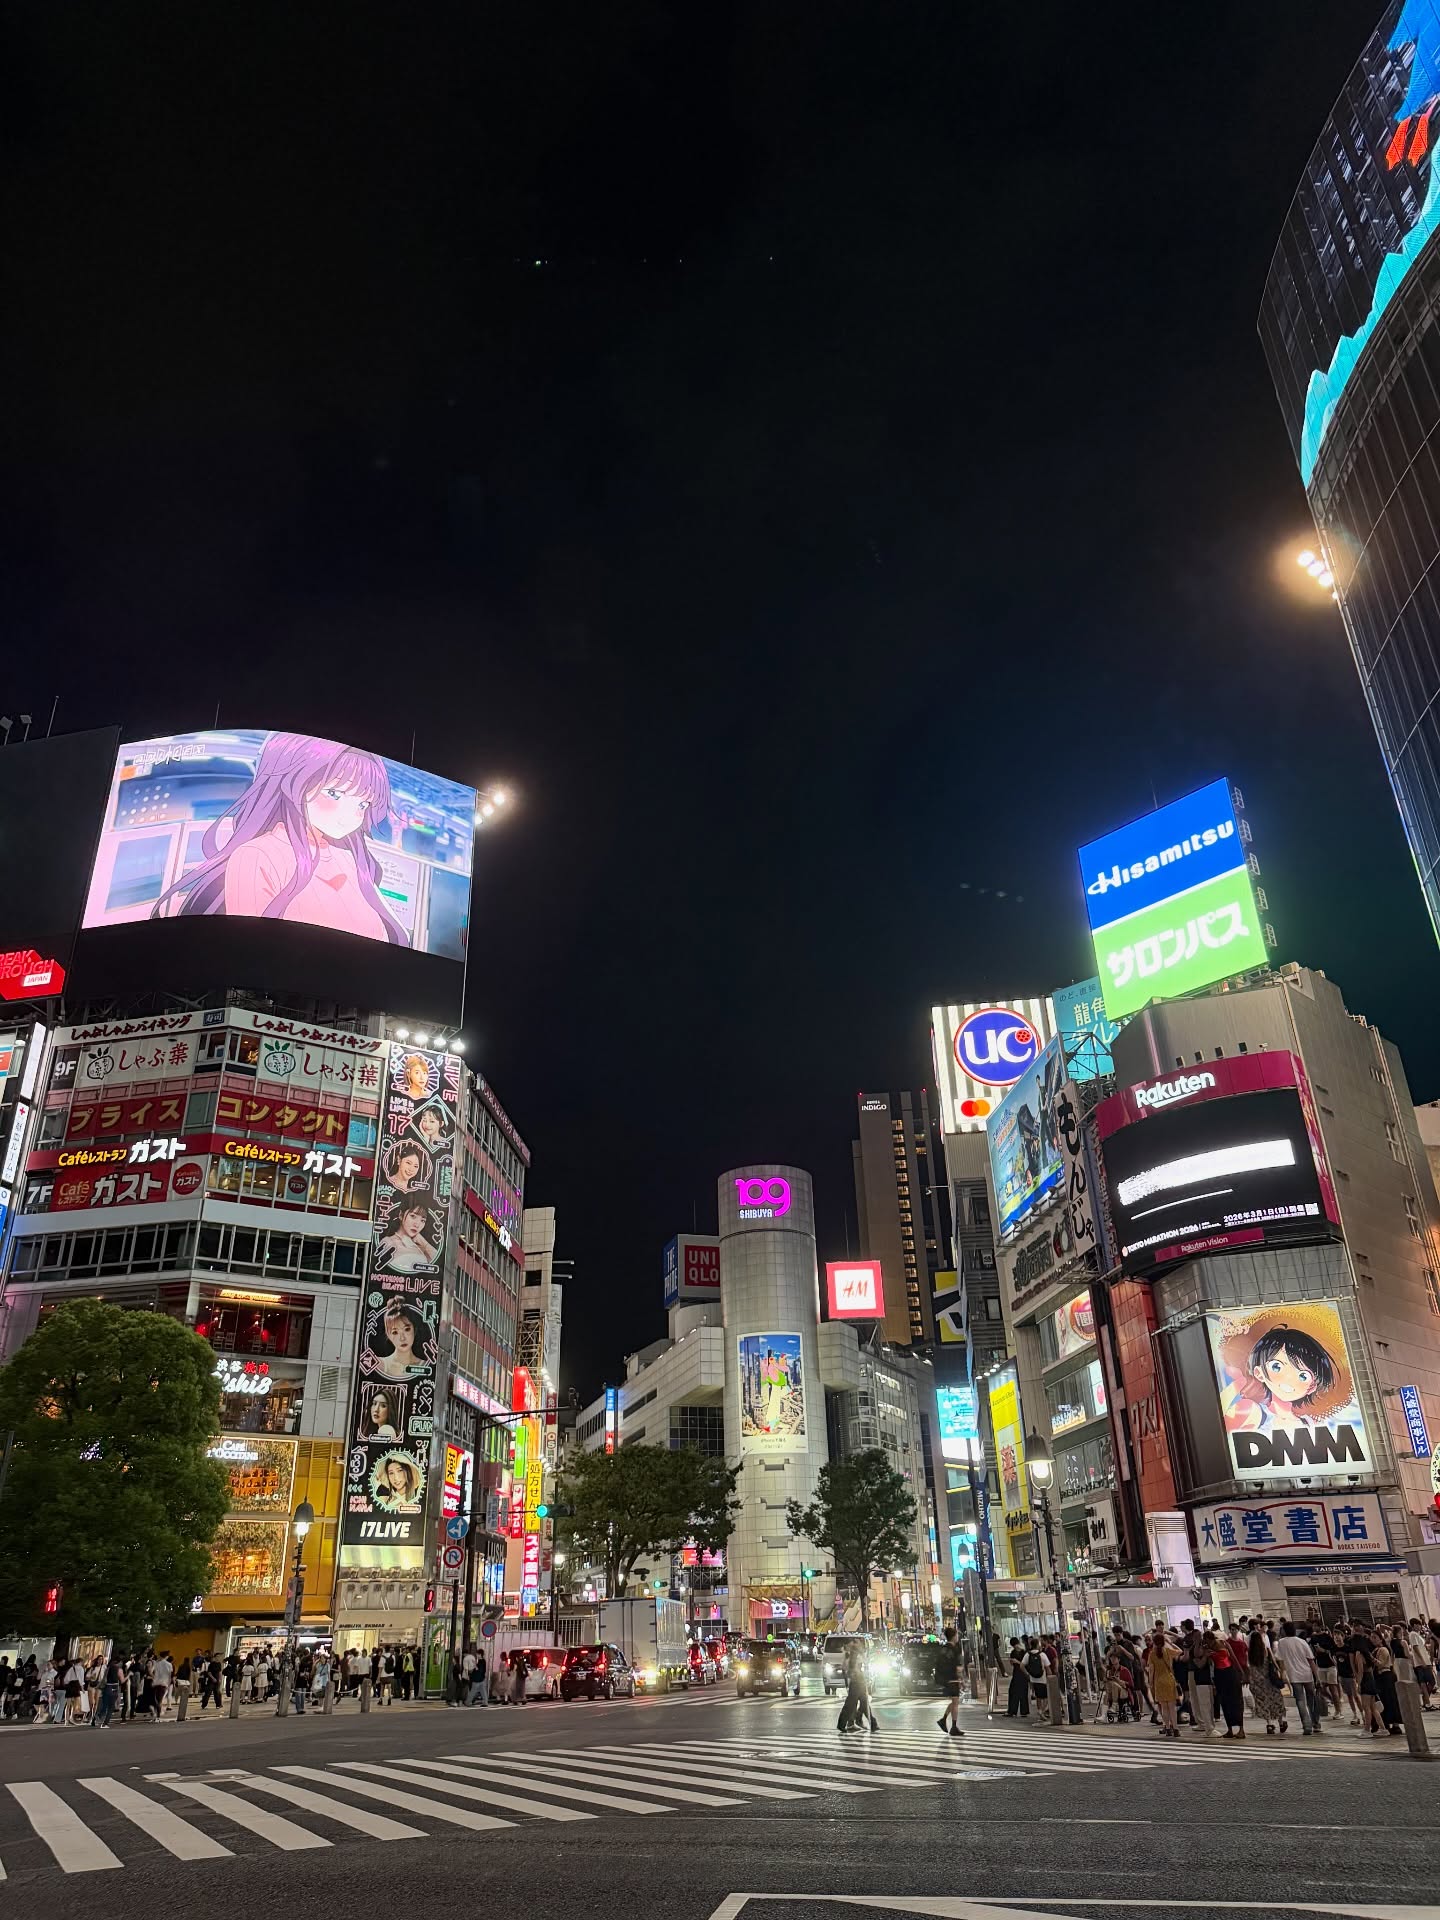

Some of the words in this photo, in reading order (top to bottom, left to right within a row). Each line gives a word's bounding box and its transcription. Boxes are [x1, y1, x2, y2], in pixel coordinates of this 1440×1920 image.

[1088, 820, 1234, 895] Hisamitsu
[1106, 901, 1249, 988] サロンパス
[27, 975, 49, 983] JAPAN
[71, 1014, 192, 1040] しゃぶしゃぶバイキング
[252, 1015, 382, 1052] しゃぶしゃぶバイキング
[54, 1060, 76, 1077] 9F
[119, 1042, 188, 1070] しゃぶ葉
[303, 1053, 379, 1088] しゃぶ葉
[1135, 1072, 1215, 1109] Rakuten
[71, 1100, 180, 1133] プライス
[219, 1097, 346, 1137] コンタクト
[388, 1114, 412, 1136] 17
[129, 1138, 187, 1163] ガスト
[303, 1151, 361, 1178] ガスト
[27, 1184, 54, 1204] 7F
[60, 1179, 90, 1196] Café
[91, 1172, 162, 1205] ガスト
[735, 1177, 791, 1217] 109
[740, 1208, 773, 1218] SHIBUYA
[1127, 1239, 1143, 1253] TOKYO
[1144, 1228, 1179, 1246] MARATHON
[1179, 1224, 1199, 1236] 2026
[1181, 1240, 1207, 1253] Rakuten
[1207, 1236, 1229, 1247] Vision
[689, 1250, 716, 1265] UNI
[405, 1277, 440, 1295] LIVE
[689, 1268, 719, 1283] QLO
[1232, 1424, 1366, 1470] DMM
[360, 1521, 411, 1538] 17LIVE
[1201, 1506, 1369, 1550] 大盛堂書店
[487, 1540, 504, 1564] LUSH
